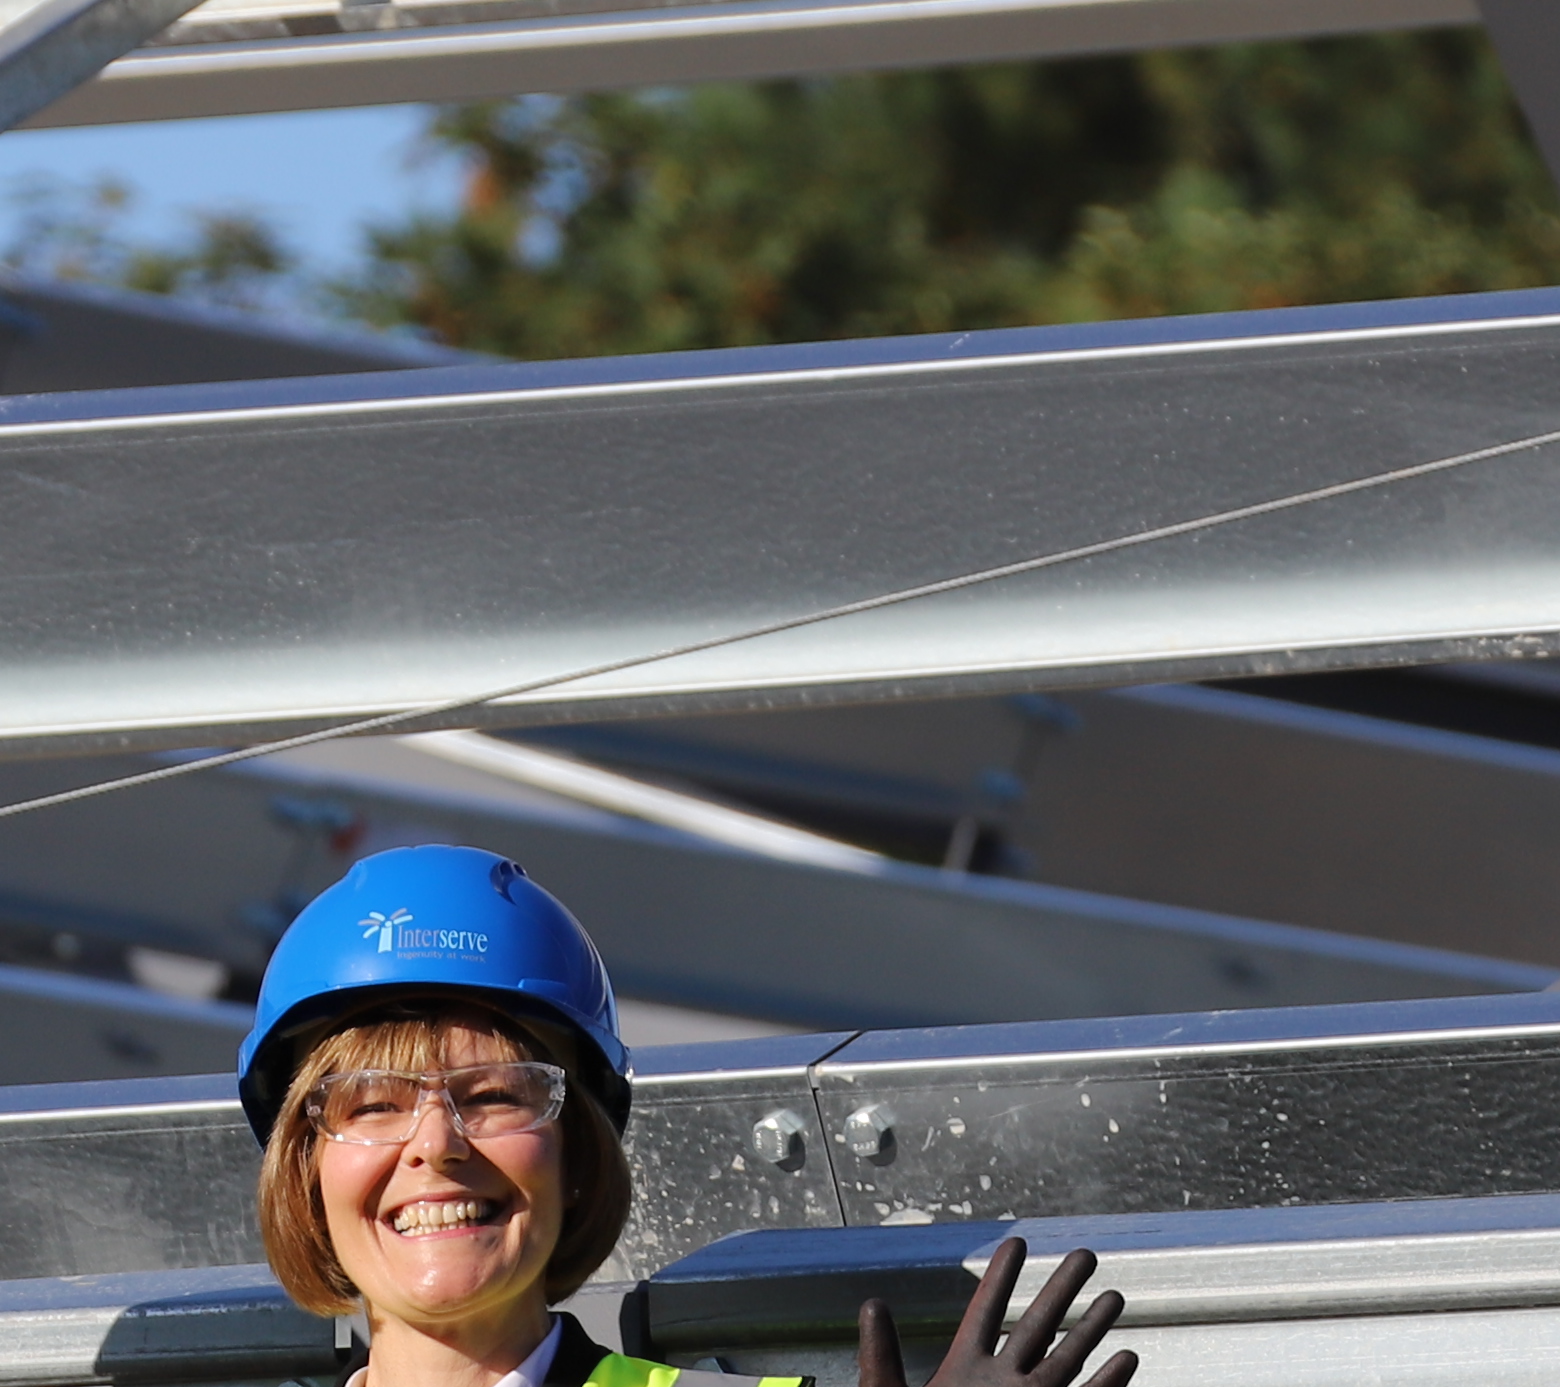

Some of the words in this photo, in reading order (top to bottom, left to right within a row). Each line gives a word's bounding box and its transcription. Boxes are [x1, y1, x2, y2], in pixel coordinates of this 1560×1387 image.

[397, 925, 489, 953] Interserve
[446, 952, 457, 960] at
[460, 953, 487, 963] work
